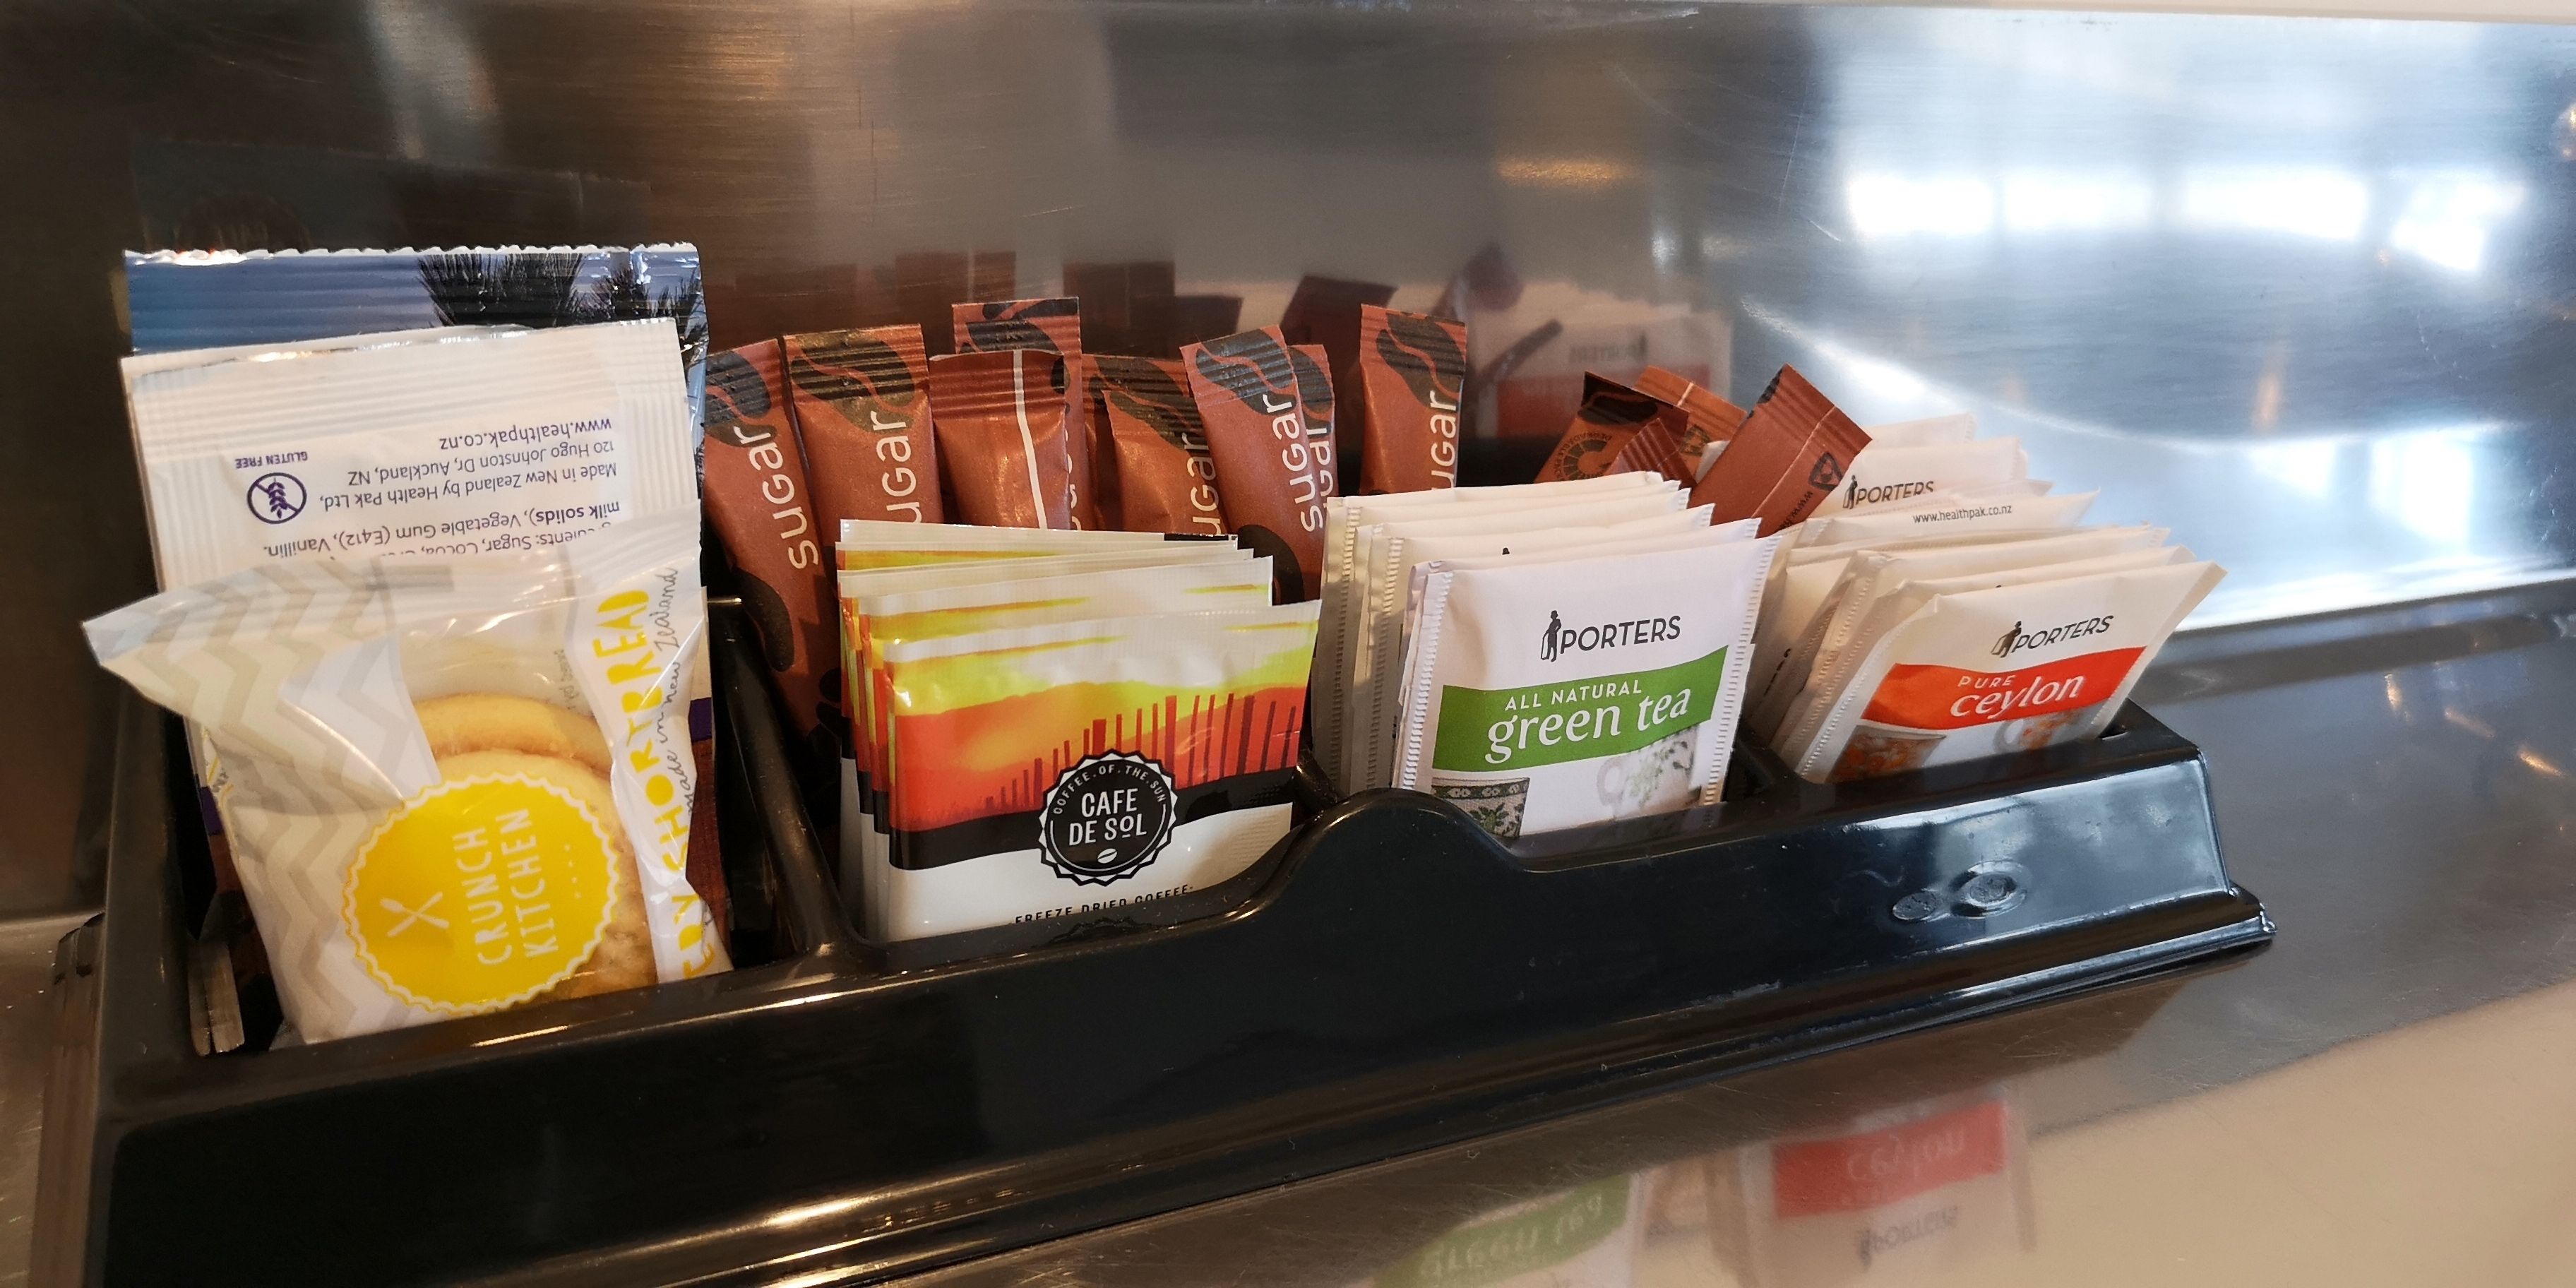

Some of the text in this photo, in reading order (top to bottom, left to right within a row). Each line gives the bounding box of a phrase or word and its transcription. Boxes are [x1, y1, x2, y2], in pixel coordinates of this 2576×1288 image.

[439, 418, 612, 451] www.healthpak.co.nz
[235, 451, 308, 469] GLUTEN FREE
[347, 441, 614, 486] 120 Hugo Johnston Dr, Auckland, NZ
[320, 463, 616, 512] Made in New Zealand by Health Pak Ltd,
[1855, 480, 1934, 505] PORTERS
[441, 511, 521, 537] Vegetable
[524, 506, 584, 527] solids),
[589, 501, 620, 519] milk
[1912, 505, 2012, 523] www.healthpak.co.nz
[333, 525, 390, 551] (E412),
[396, 524, 436, 539] Gum
[482, 533, 532, 550] Sugar,
[263, 537, 331, 559] Vanillin.
[650, 567, 679, 650] Zealand
[1560, 615, 1681, 655] PORTERS
[2011, 615, 2114, 653] PORTERS
[1505, 679, 1642, 711] ALL NATURAL
[1957, 674, 2017, 689] PURE
[1950, 675, 2085, 720] ceylon
[655, 708, 667, 743] in
[1484, 688, 1691, 764] green tea
[1053, 764, 1166, 814] COFFEE OF THE SUN
[1081, 788, 1138, 818] CAFE
[1069, 820, 1097, 846] DE
[453, 828, 512, 965] CRUNCH
[496, 809, 559, 958] KITCHEN
[1081, 898, 1127, 913] DRIED
